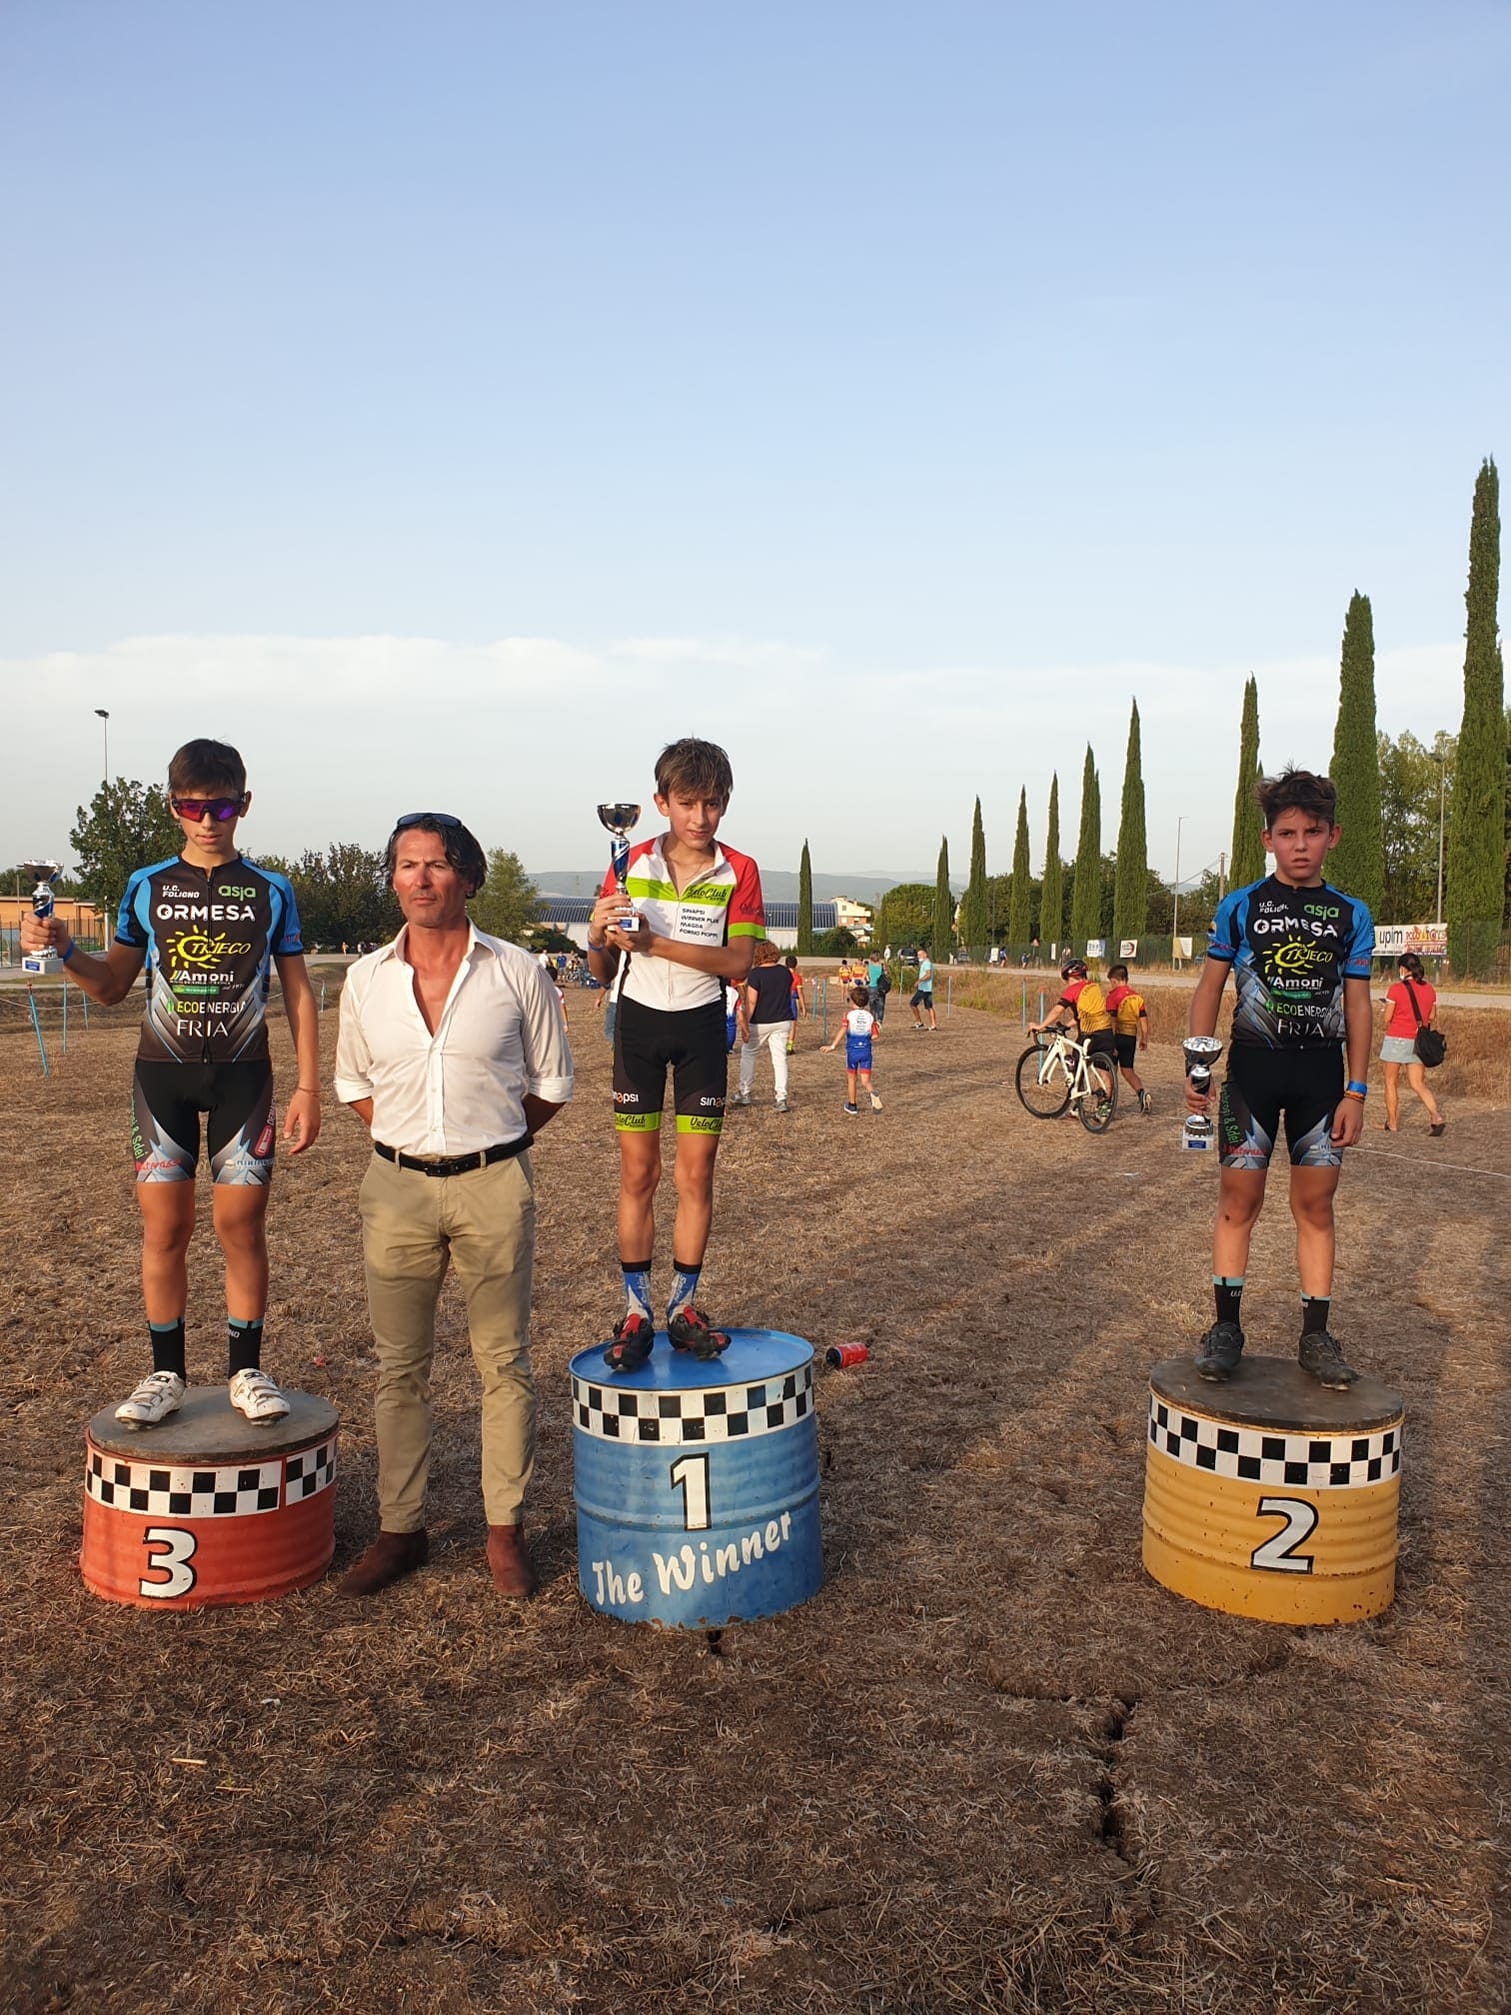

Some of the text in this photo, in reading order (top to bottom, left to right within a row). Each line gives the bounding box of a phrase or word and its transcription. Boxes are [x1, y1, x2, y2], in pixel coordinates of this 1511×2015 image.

[156, 904, 256, 921] ORMESA
[1253, 916, 1338, 938] ORMESA
[1380, 926, 1402, 948] upim
[179, 970, 234, 982] Amoni
[1273, 976, 1324, 988] Amoni
[177, 1019, 229, 1037] FRIA
[1277, 1019, 1325, 1038] FRIA
[670, 1451, 712, 1532] 1
[1250, 1496, 1320, 1575] 2
[139, 1526, 197, 1599] 3
[592, 1510, 793, 1606] The Winner
